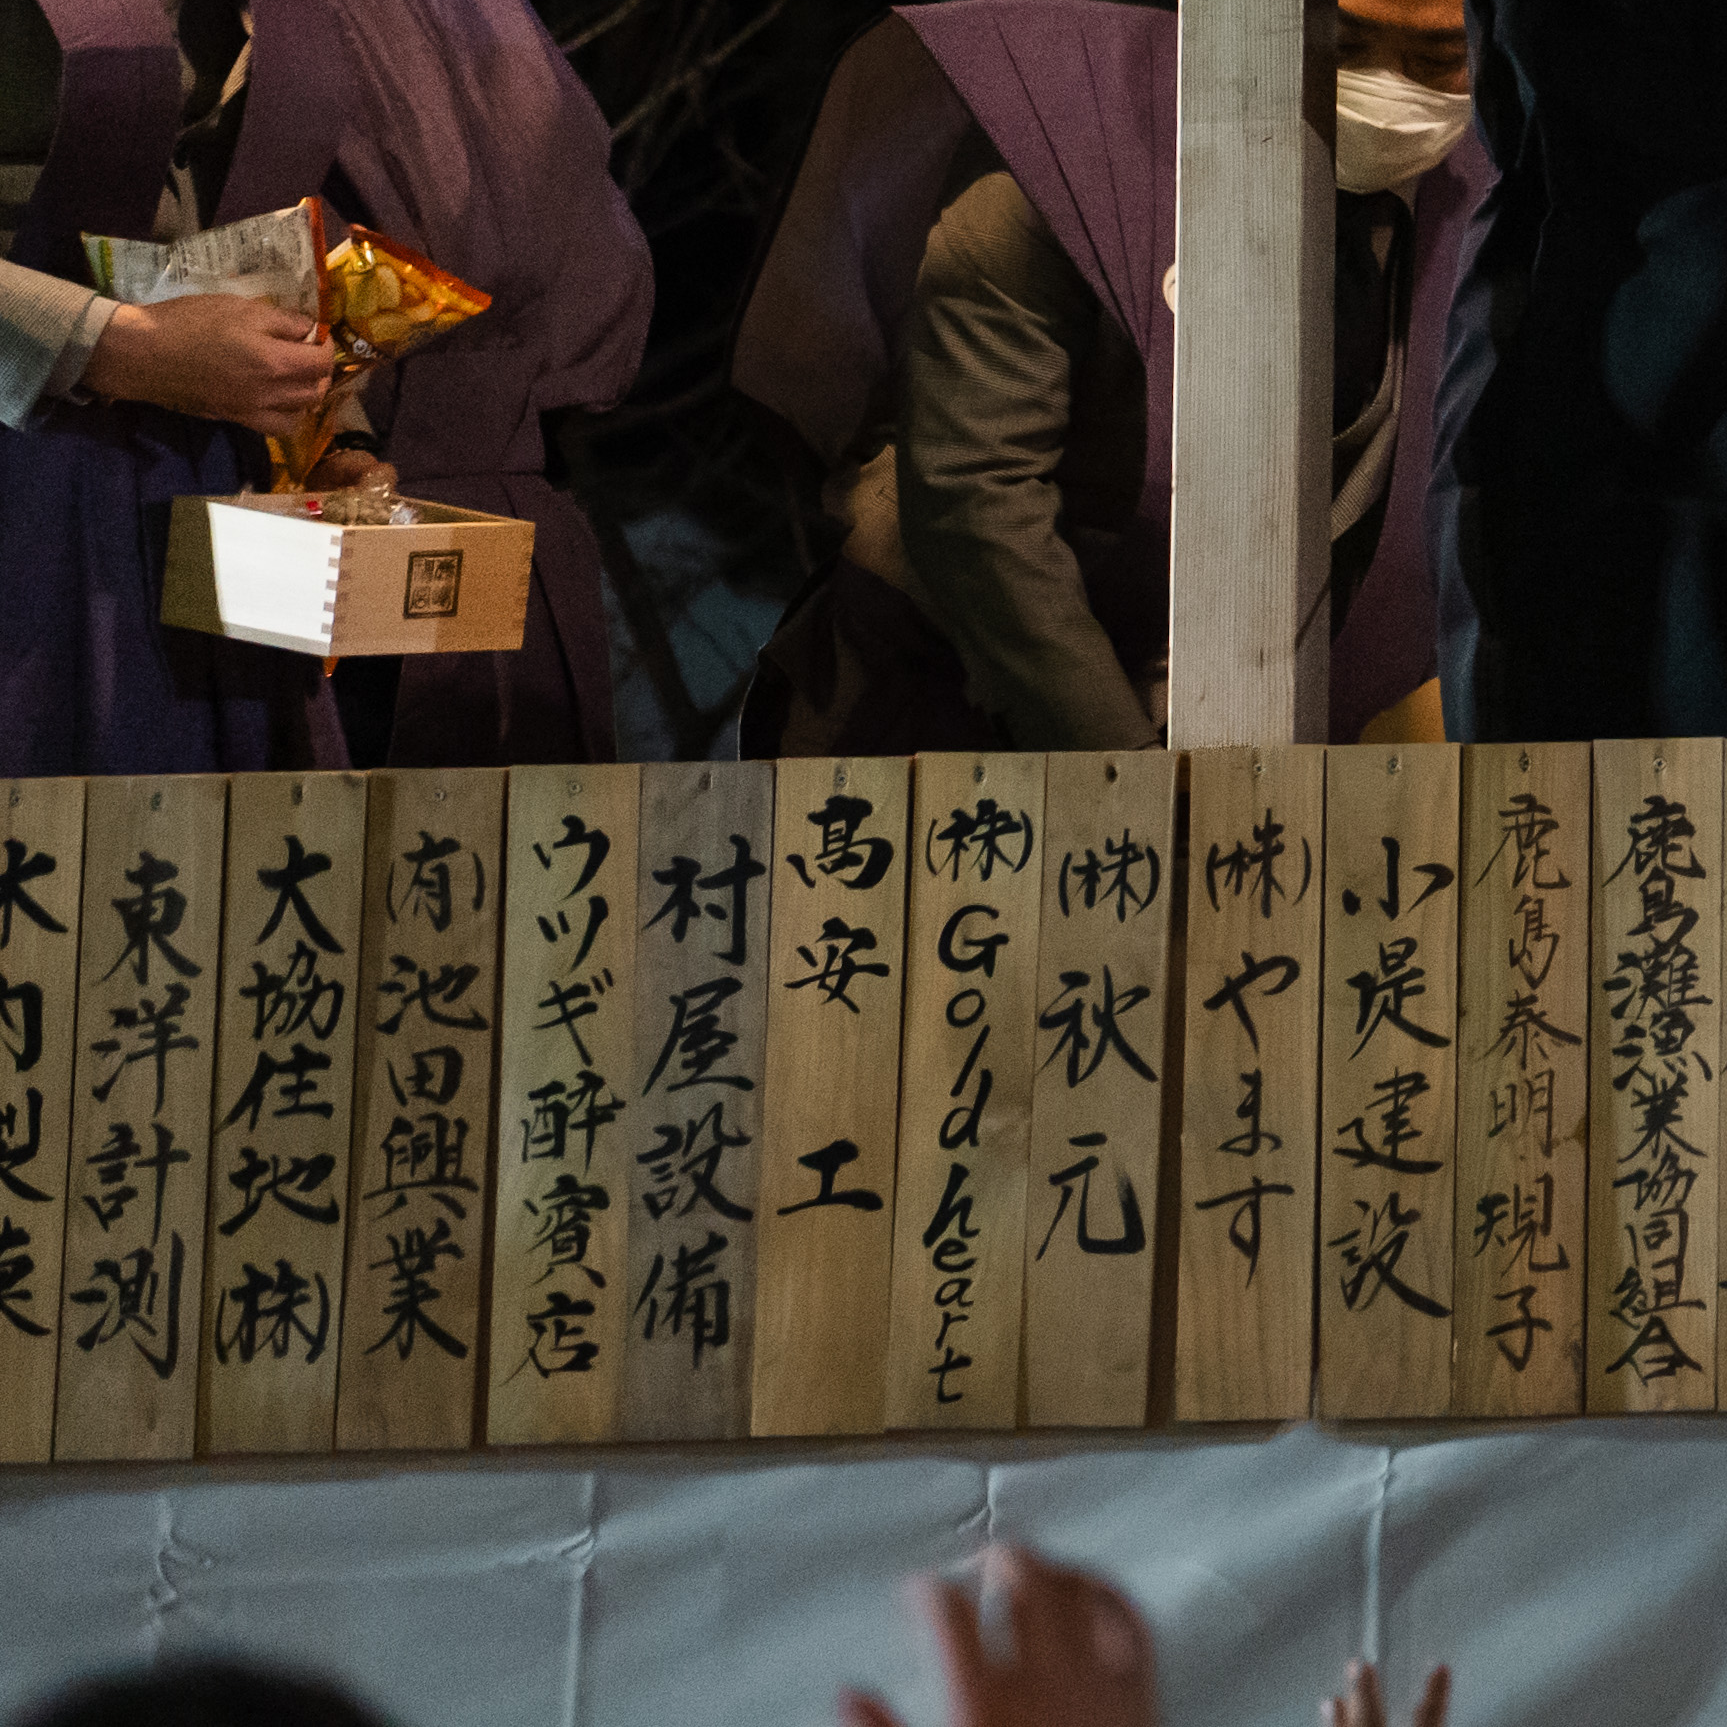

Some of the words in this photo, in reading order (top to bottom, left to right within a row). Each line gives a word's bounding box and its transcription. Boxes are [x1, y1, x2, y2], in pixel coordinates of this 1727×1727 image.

[70, 851, 202, 1379] 東洋計測
[634, 835, 766, 1368] 村屋設備
